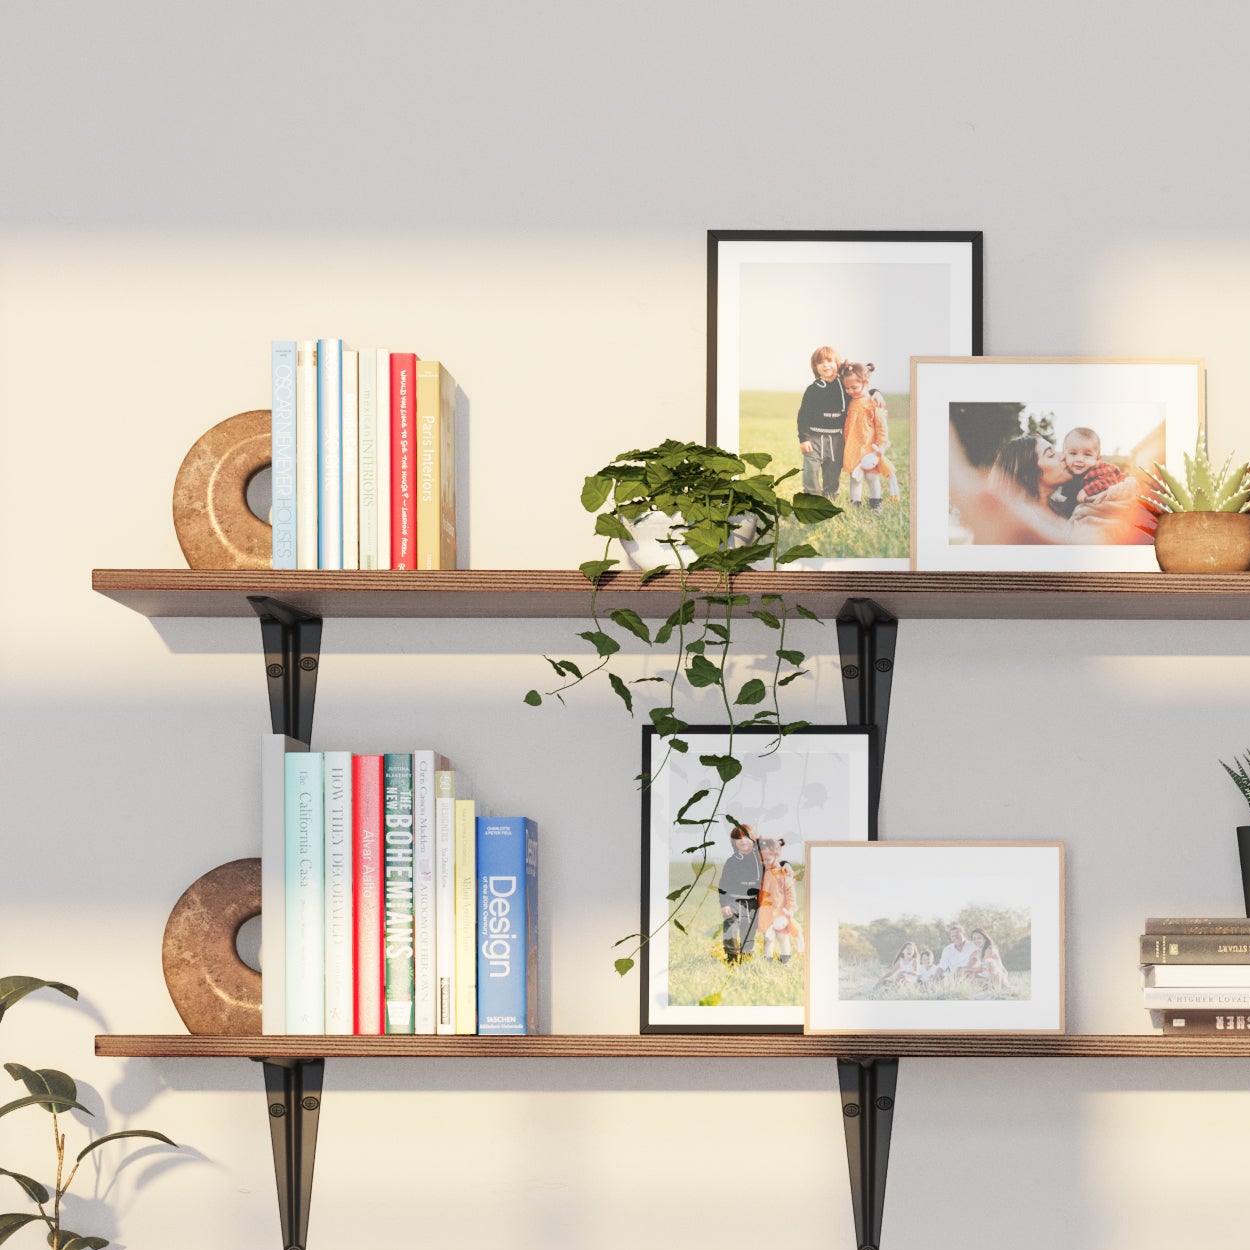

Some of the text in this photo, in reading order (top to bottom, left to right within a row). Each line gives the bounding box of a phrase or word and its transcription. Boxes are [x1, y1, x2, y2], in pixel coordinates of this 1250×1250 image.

[274, 364, 293, 420] OSCAR
[399, 369, 408, 396] WOULD
[362, 389, 373, 437] mexican
[400, 429, 407, 439] TO
[275, 422, 293, 497] NIEMEYER
[361, 438, 375, 508] INTERIORS
[422, 415, 436, 503] Paris Interiors
[276, 498, 292, 560] HOUSES
[331, 768, 344, 801] HOW
[386, 787, 398, 810] NEW
[400, 790, 411, 810] THE
[299, 792, 313, 854] California
[331, 806, 344, 848] THEY
[419, 817, 429, 853] Madden
[362, 829, 374, 861] Alvar
[299, 858, 313, 888] Casa
[362, 864, 375, 899] Aalto
[386, 814, 413, 959] BOHEMIANS
[482, 875, 488, 883] of
[331, 852, 345, 945] DECORATED
[481, 910, 489, 936] Century
[481, 876, 518, 977] Design
[1217, 944, 1248, 953] STUART
